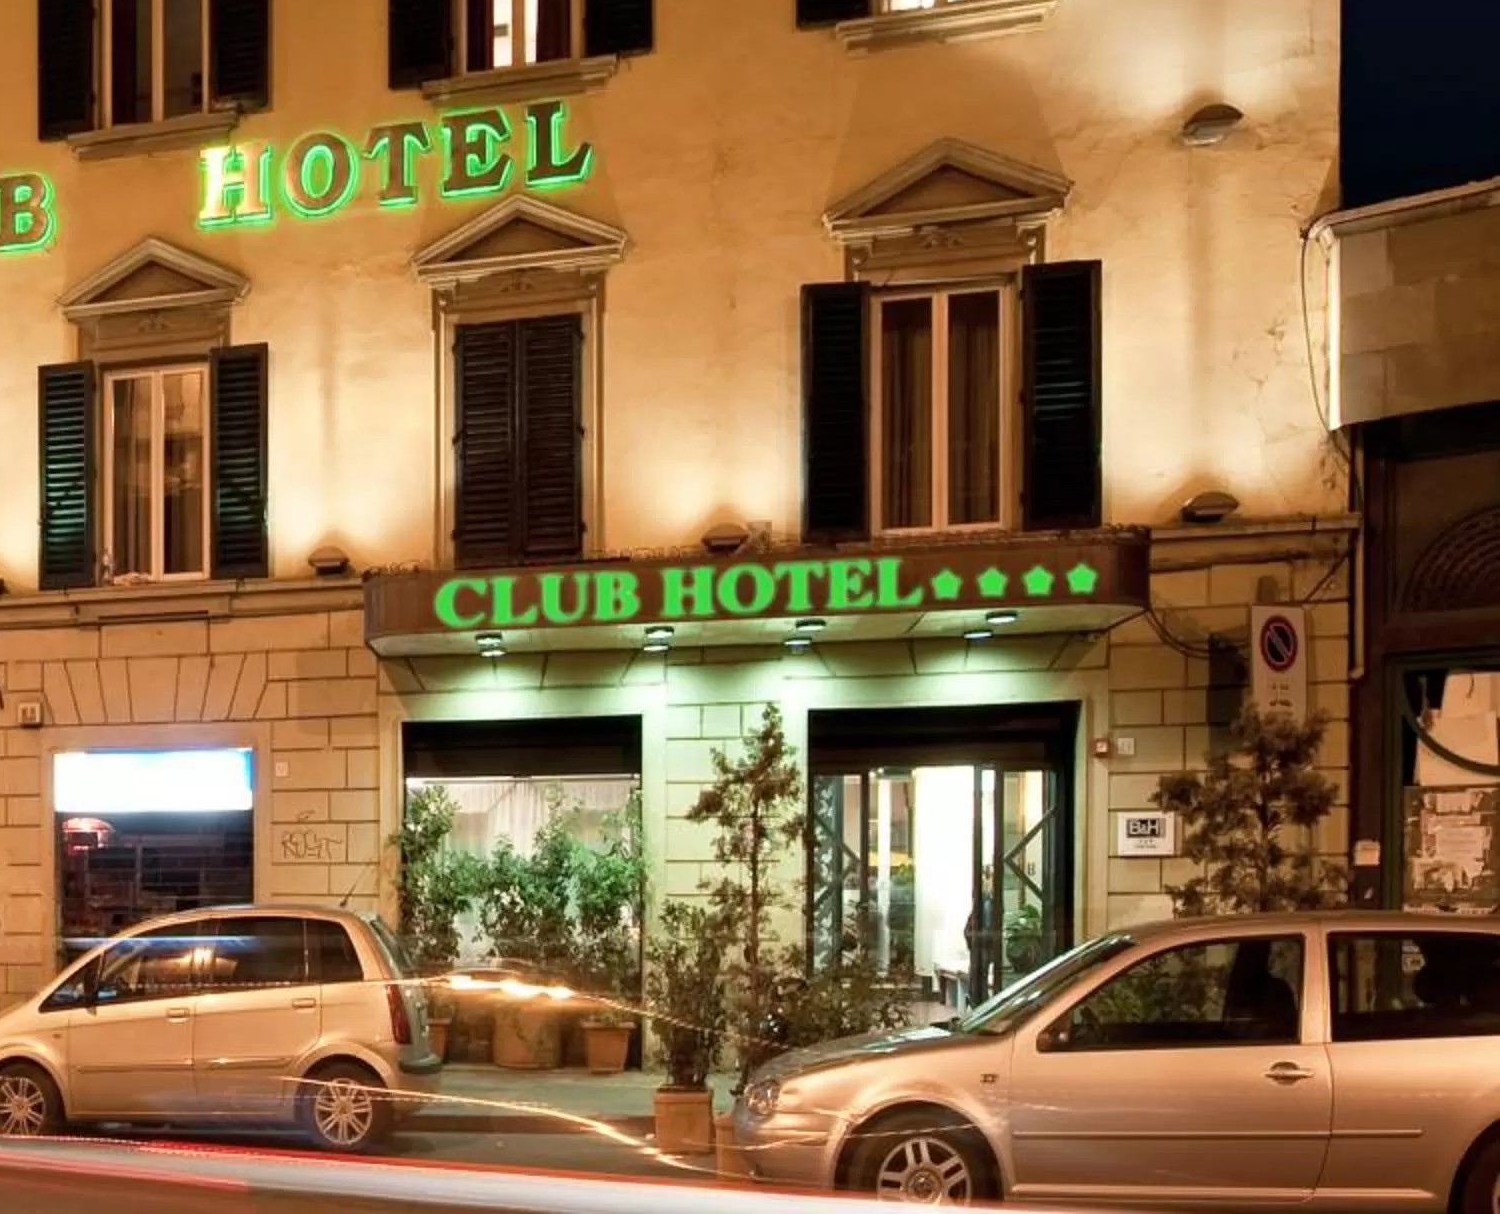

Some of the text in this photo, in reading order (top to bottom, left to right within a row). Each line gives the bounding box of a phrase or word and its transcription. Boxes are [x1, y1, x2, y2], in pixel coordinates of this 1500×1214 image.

[197, 99, 593, 229] HOTEL
[434, 556, 924, 628] CLUB HOTEL
